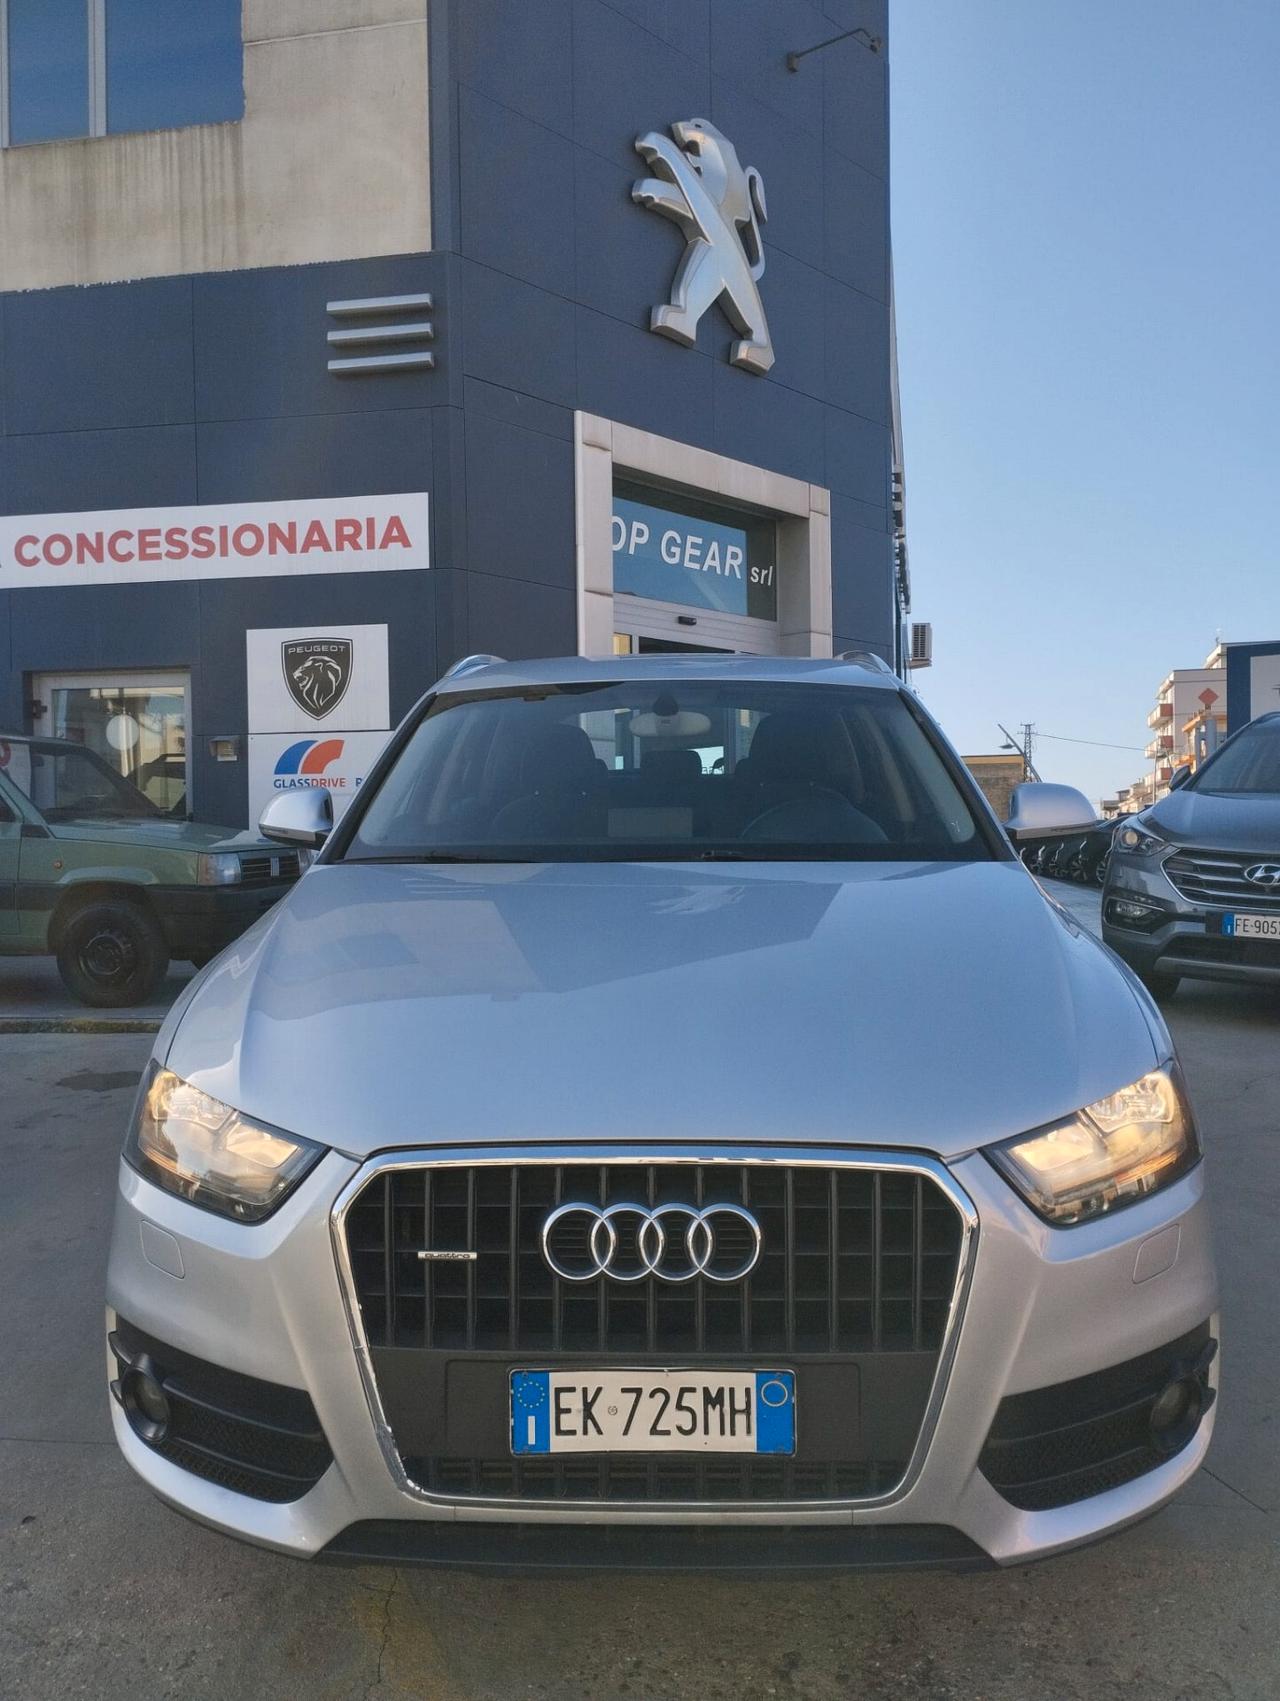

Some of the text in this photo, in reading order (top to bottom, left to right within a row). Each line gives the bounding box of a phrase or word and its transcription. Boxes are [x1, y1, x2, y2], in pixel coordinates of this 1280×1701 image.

[13, 515, 412, 568] CONCESSIONARIA
[661, 530, 742, 579] GEAR
[750, 566, 773, 586] srl
[287, 645, 346, 655] PEUGEOT
[273, 777, 346, 789] GLASSDRIVE
